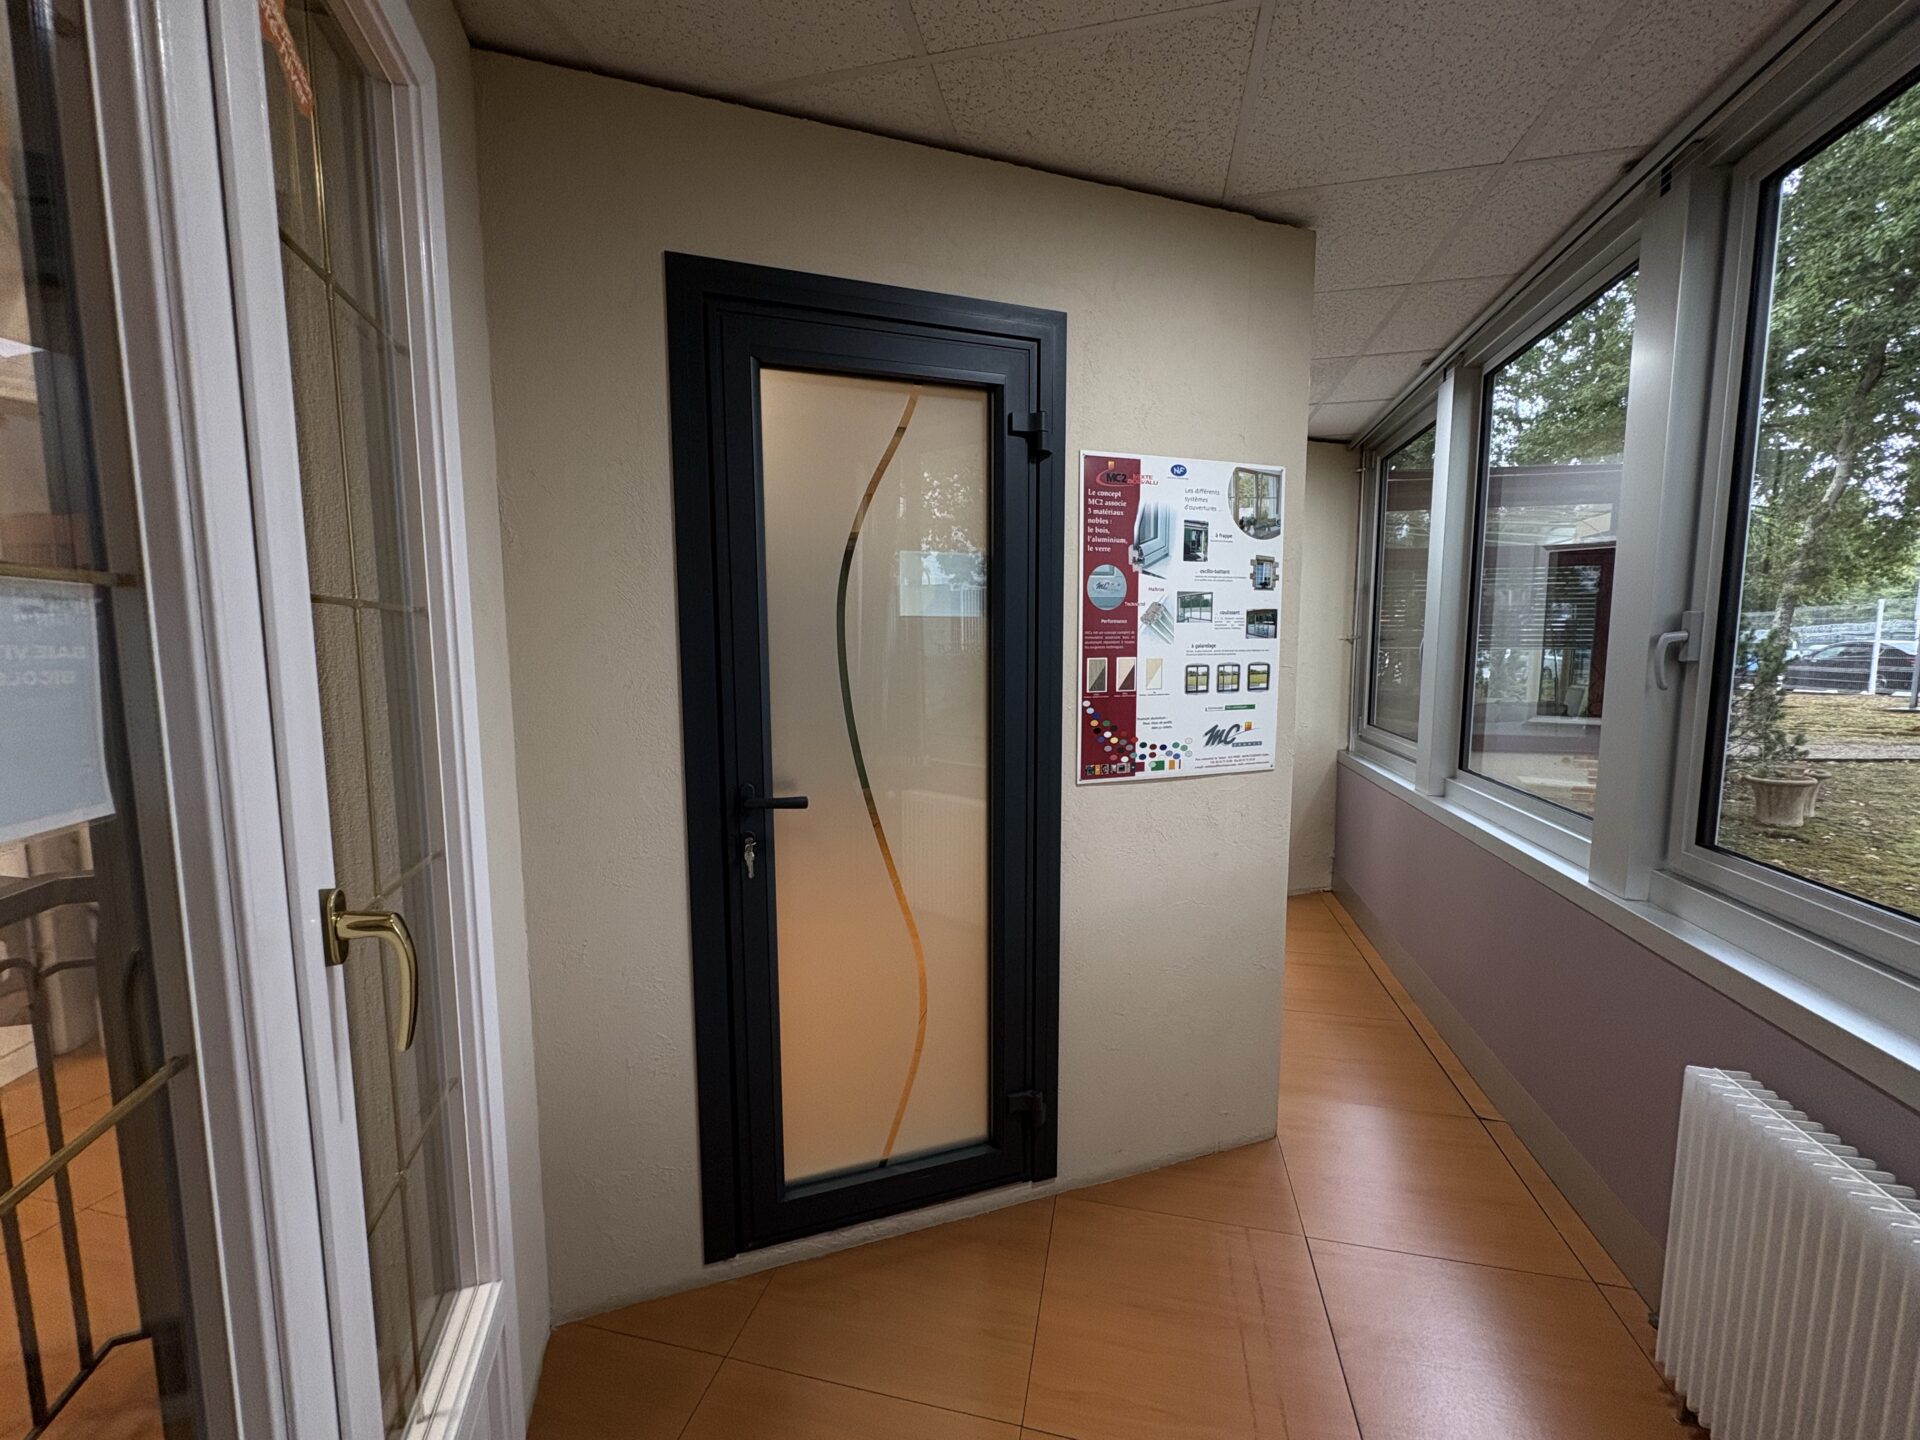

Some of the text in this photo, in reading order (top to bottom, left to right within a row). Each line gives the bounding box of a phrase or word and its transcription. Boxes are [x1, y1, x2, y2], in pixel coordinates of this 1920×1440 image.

[1173, 466, 1186, 475] NF
[1106, 472, 1127, 483] MC2
[1088, 488, 1121, 500] Le concept
[1088, 498, 1104, 506] MC2
[1093, 508, 1124, 516] matériaux
[1088, 517, 1109, 525] nobles
[1095, 526, 1111, 535] bois,
